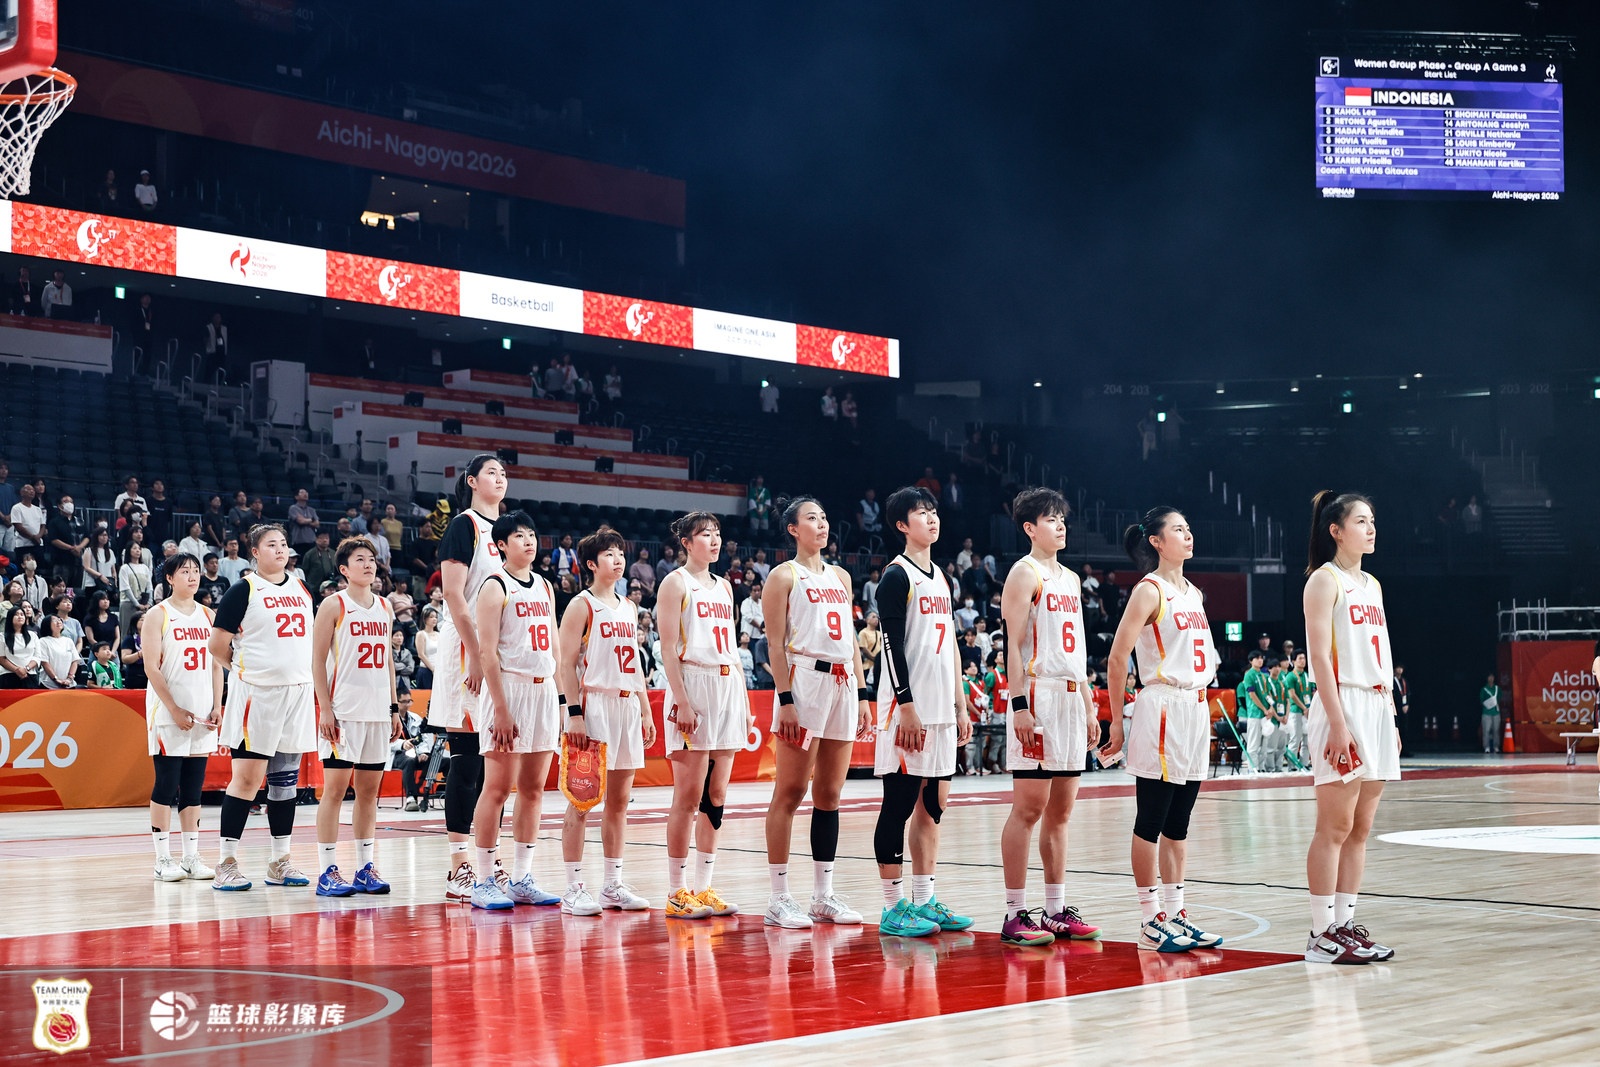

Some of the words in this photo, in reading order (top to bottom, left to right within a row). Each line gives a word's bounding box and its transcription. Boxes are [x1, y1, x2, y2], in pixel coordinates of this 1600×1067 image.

[1354, 58, 1388, 68] Women
[1389, 60, 1417, 72] Group
[1418, 60, 1446, 70] Phase
[1454, 62, 1482, 72] Group
[1484, 62, 1490, 71] A
[1492, 62, 1518, 72] Game
[1520, 64, 1526, 72] 3
[1374, 91, 1454, 106] INDONESIA
[316, 120, 464, 172] Aichi-Nagoya
[466, 150, 517, 178] 2026
[1320, 166, 1347, 174] Coach:
[1492, 191, 1540, 201] Aichi-Nagoya
[1541, 192, 1560, 200] 2026
[491, 292, 554, 312] Basketball
[714, 322, 743, 334] IMAGINE
[745, 328, 759, 336] ONE
[761, 330, 776, 338] ASIA
[264, 596, 306, 609] CHINA
[806, 588, 850, 604] CHINA
[516, 602, 550, 617] CHINA
[174, 628, 211, 641] CHINA
[276, 613, 306, 638] 23
[350, 621, 388, 636] CHINA
[600, 621, 636, 639] CHINA
[826, 612, 842, 641] 9
[528, 624, 550, 651] 18
[712, 626, 731, 654] 11
[935, 623, 946, 654] 7
[1062, 621, 1076, 653] 6
[184, 647, 206, 671] 31
[358, 642, 386, 669] 20
[614, 645, 636, 674] 12
[1194, 639, 1206, 673] 5
[1371, 635, 1383, 669] 1
[1550, 670, 1596, 686] Aichi
[1556, 708, 1594, 723] 202
